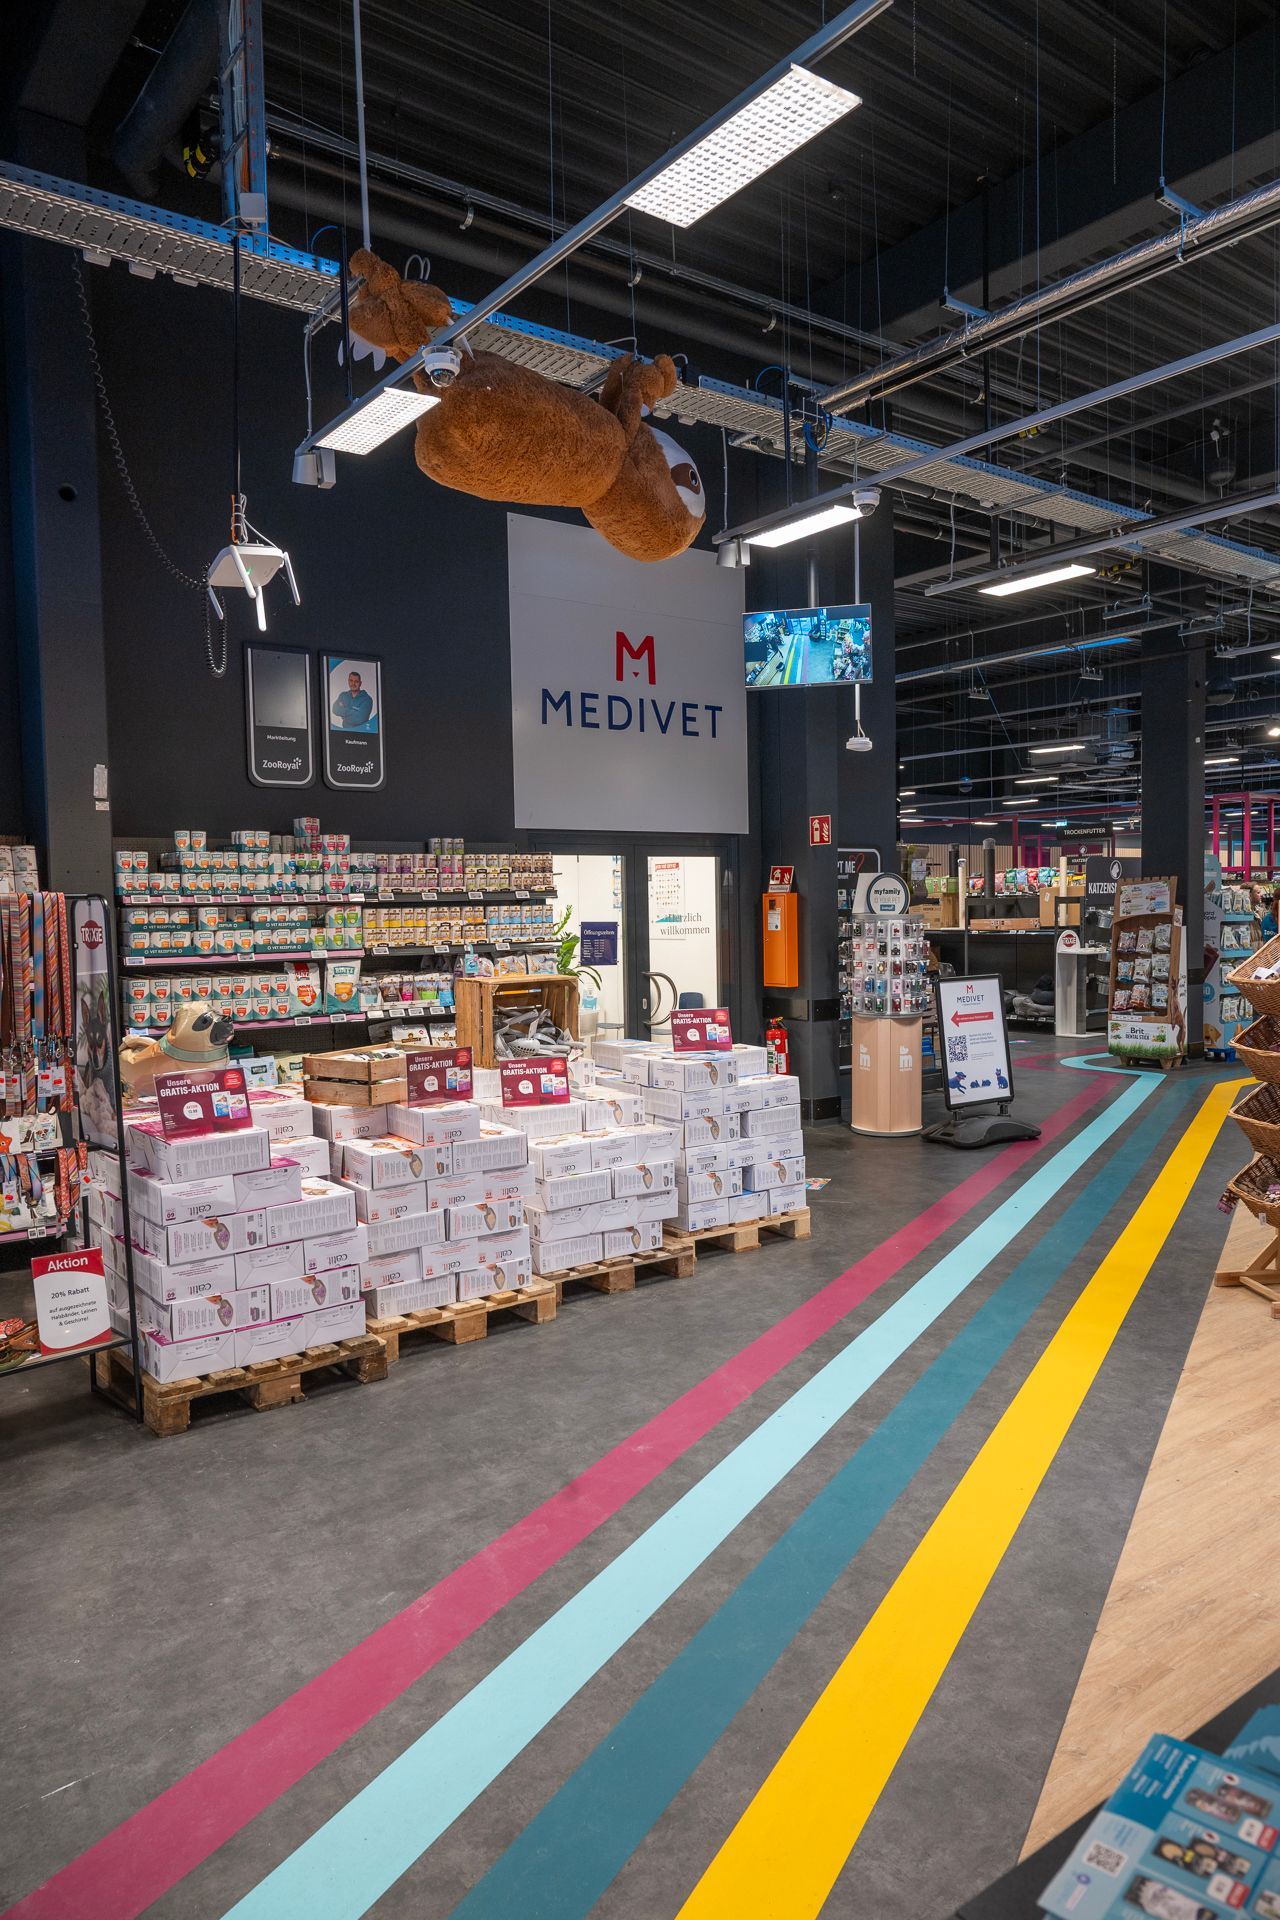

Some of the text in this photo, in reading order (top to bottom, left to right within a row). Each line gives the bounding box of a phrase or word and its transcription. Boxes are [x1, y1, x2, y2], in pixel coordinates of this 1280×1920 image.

[616, 631, 656, 686] M
[542, 688, 722, 738] MEDIVET
[262, 760, 300, 770] ZooRoyal
[337, 764, 371, 774] ZooRoyal
[1064, 828, 1106, 836] TROCKENFUTTER
[81, 927, 103, 942] TRIXIE
[660, 926, 710, 936] willkommen
[956, 995, 984, 1003] MEDIVET
[409, 1060, 452, 1072] GRATIS-AKTION
[502, 1067, 547, 1076] GRATIS-AKTION
[167, 1079, 192, 1087] Unsere
[160, 1082, 220, 1097] GRATIS-AKTION
[275, 1125, 294, 1135] catit
[352, 1125, 370, 1136] catit
[443, 1130, 462, 1140] catit
[502, 1186, 519, 1196] catit
[448, 1195, 466, 1205] catit
[187, 1204, 212, 1216] catit
[389, 1205, 408, 1216] catit
[327, 1253, 348, 1265] catit
[496, 1249, 512, 1259] catit
[48, 1256, 88, 1272] Aktion
[443, 1260, 461, 1272] catit
[380, 1272, 401, 1283] catit
[68, 1287, 89, 1296] Rabatt
[187, 1283, 212, 1295] catit
